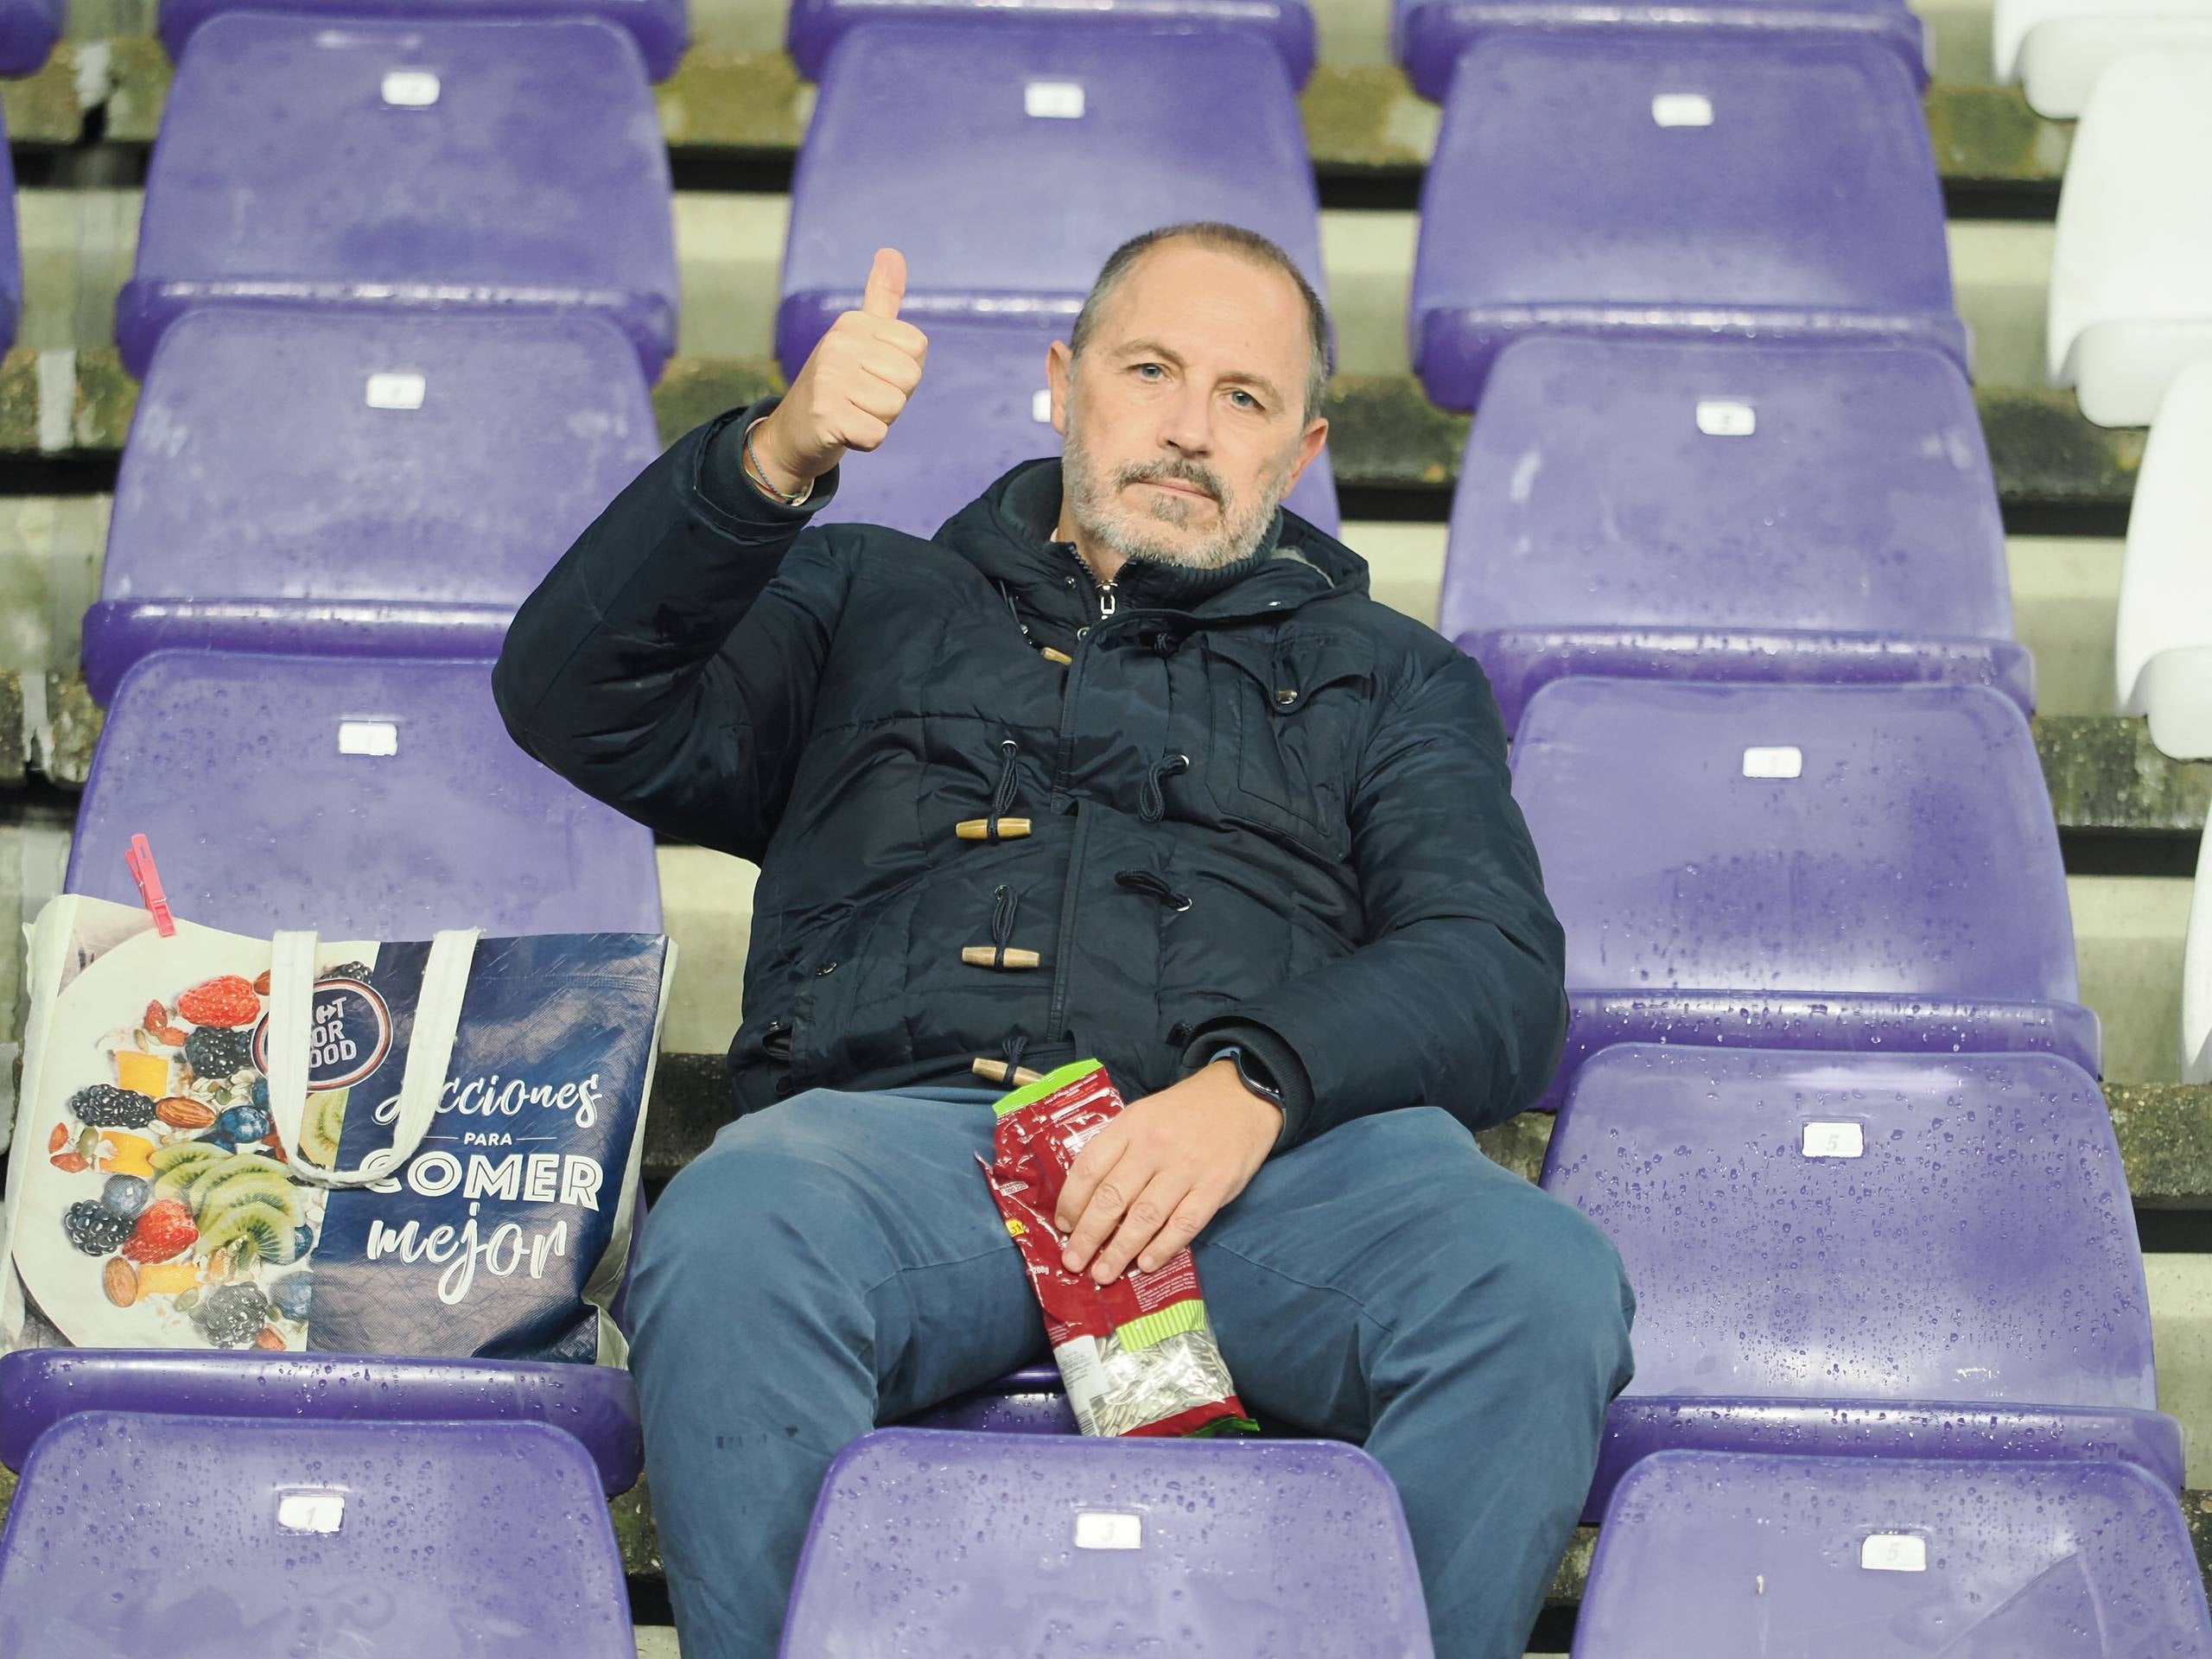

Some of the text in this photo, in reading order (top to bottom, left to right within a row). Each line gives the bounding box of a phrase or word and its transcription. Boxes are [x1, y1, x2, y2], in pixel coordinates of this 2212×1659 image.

[311, 1020, 346, 1048] OR
[308, 1039, 357, 1069] OOD
[463, 1132, 512, 1147] PARA
[1825, 1134, 1839, 1152] 5
[359, 1147, 604, 1211] COMER
[366, 1202, 568, 1305] mejor
[1102, 1522, 1117, 1542] 3
[1886, 1541, 1902, 1562] 5
